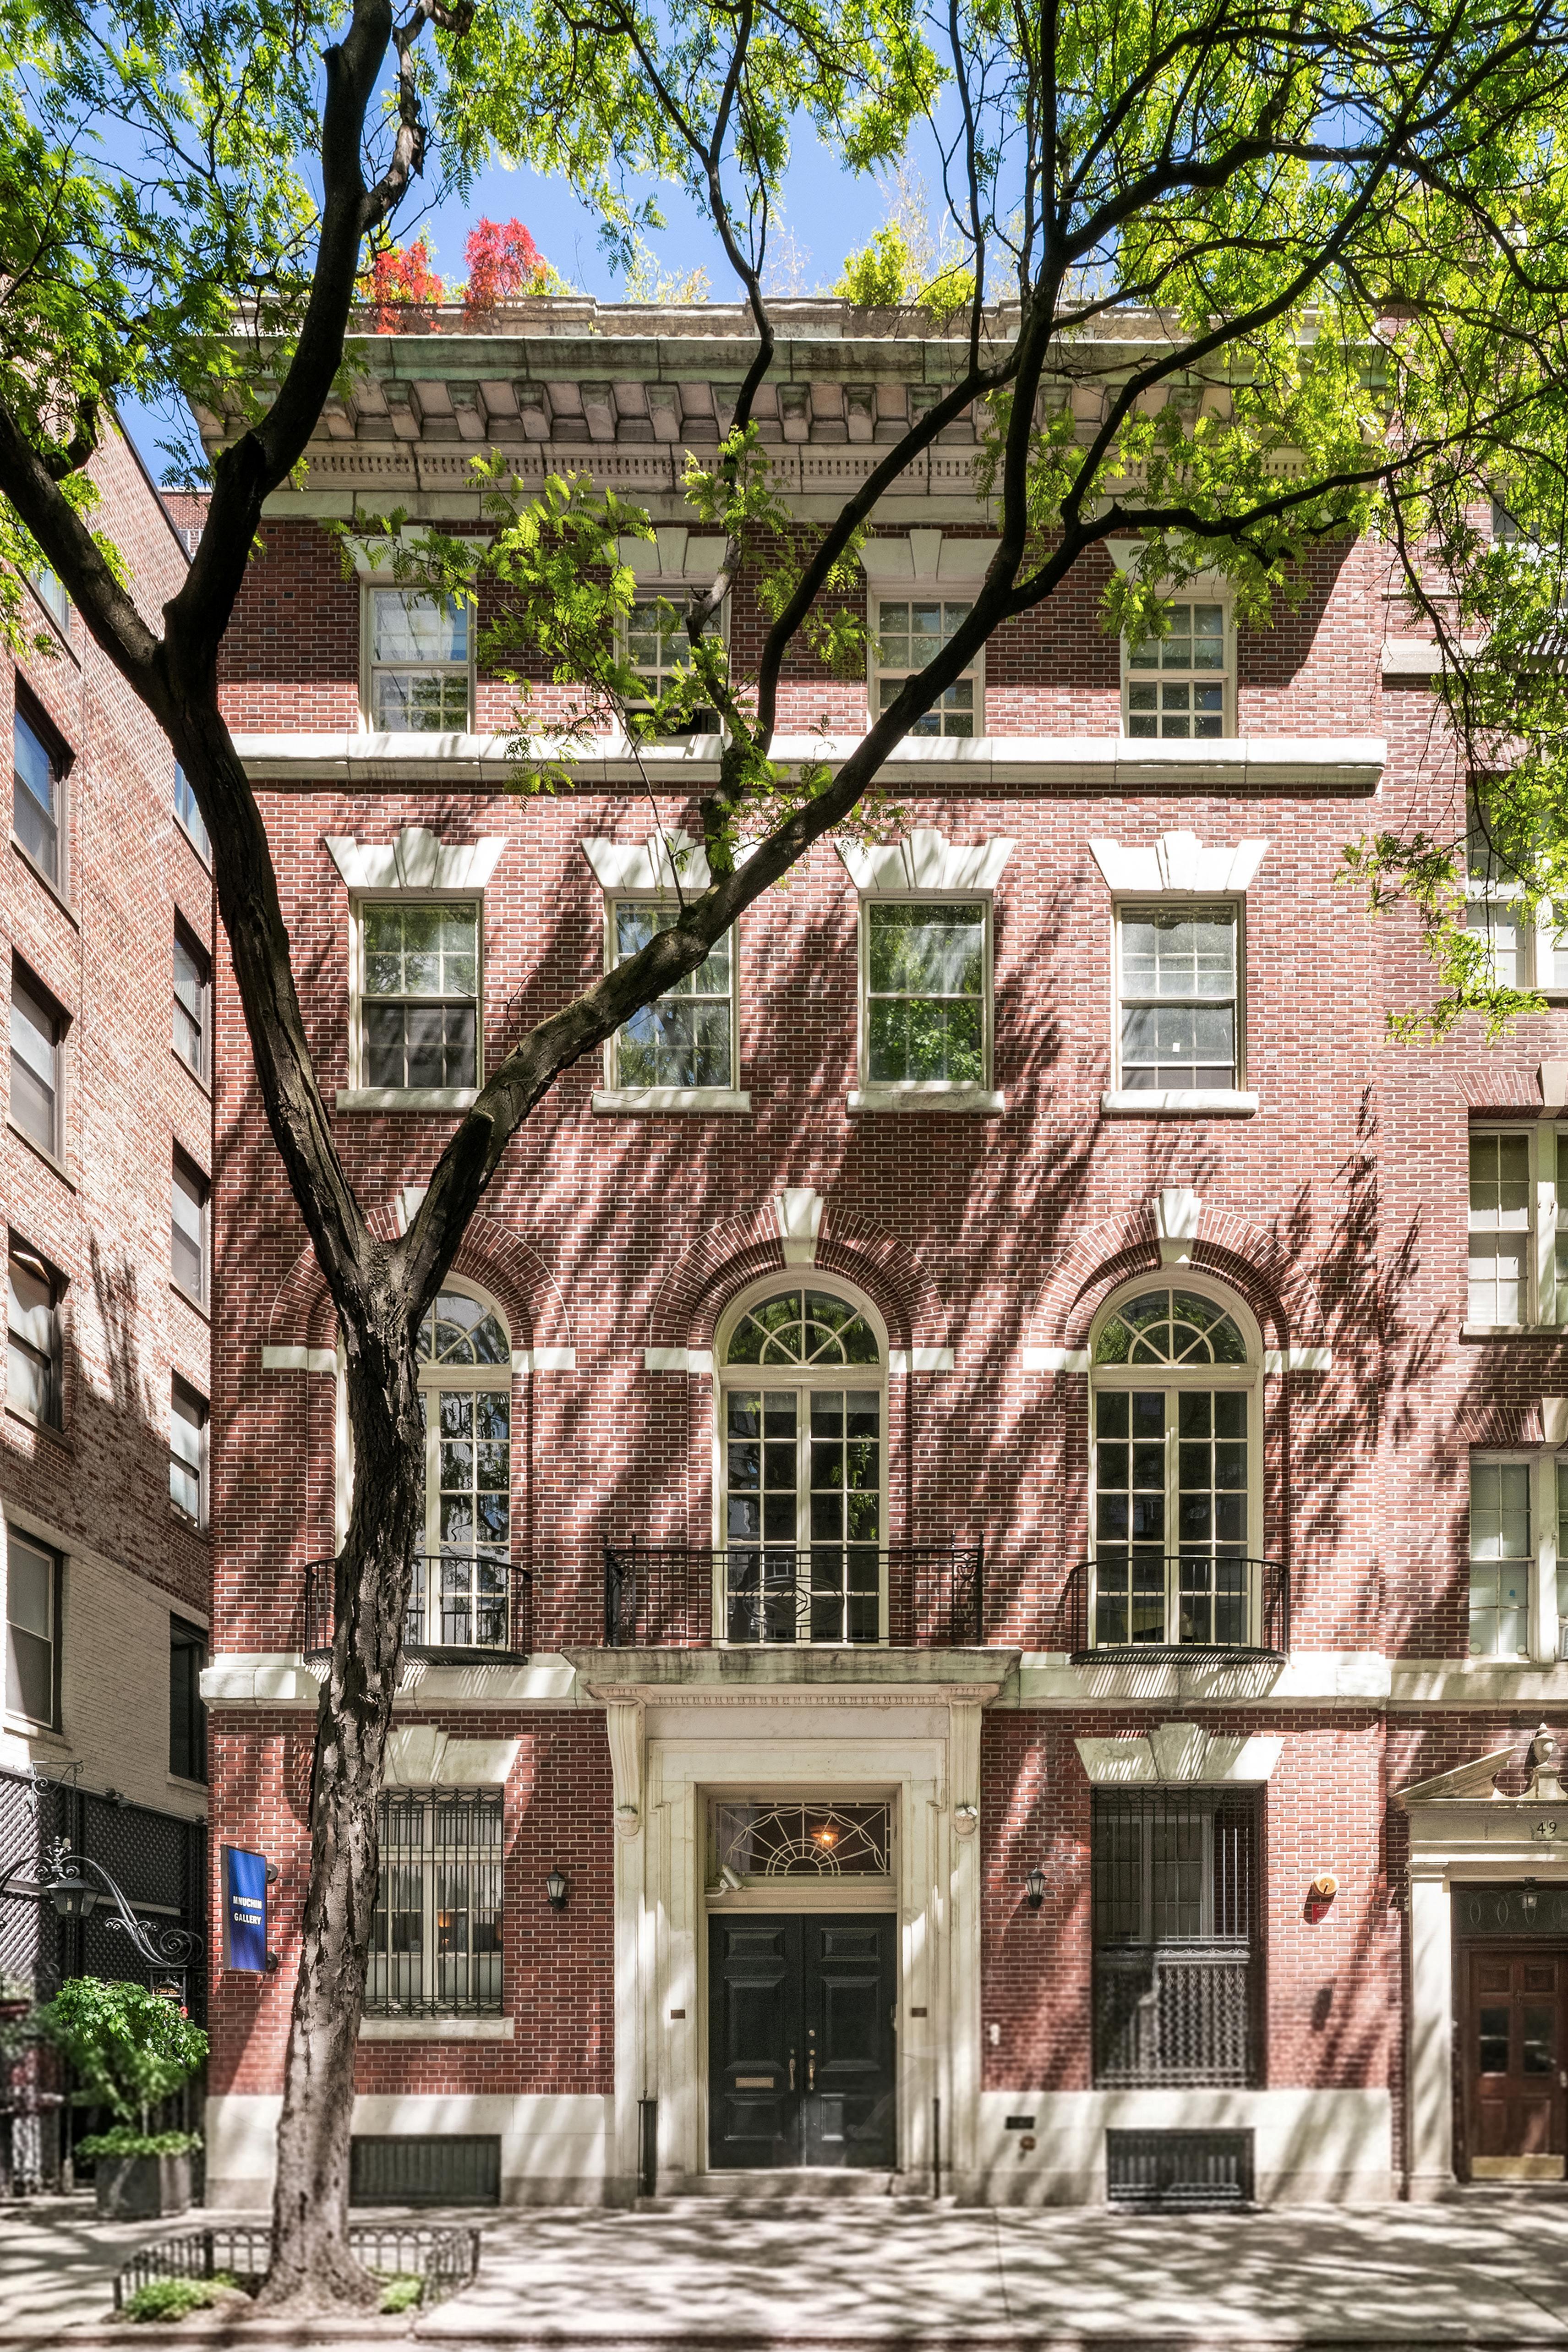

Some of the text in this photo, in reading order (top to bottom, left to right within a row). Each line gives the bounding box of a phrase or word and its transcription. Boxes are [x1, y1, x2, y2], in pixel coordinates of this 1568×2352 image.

[1537, 1822, 1557, 1834] 49
[233, 1896, 262, 1909] MNUCHIN
[234, 1912, 262, 1925] GALLERY
